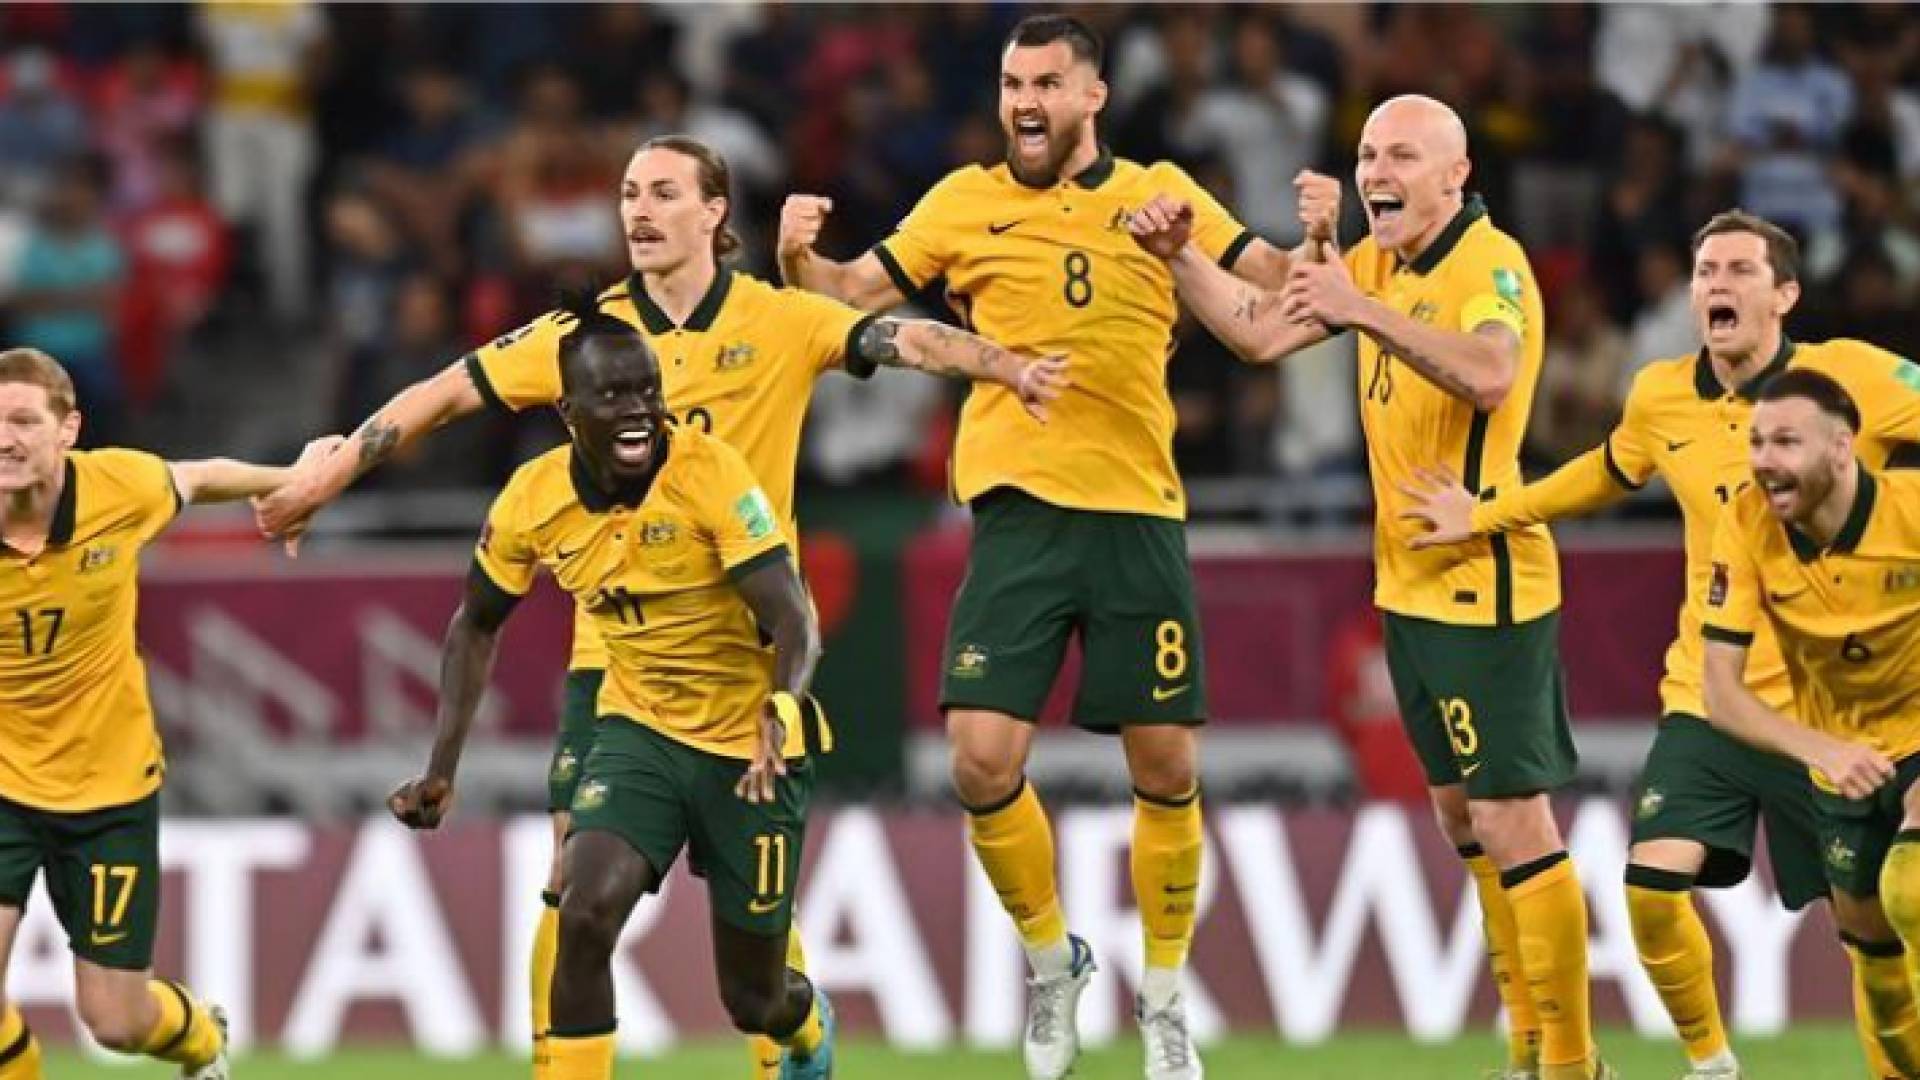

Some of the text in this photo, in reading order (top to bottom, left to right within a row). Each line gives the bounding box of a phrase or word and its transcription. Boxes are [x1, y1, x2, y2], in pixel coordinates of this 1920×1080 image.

[1064, 250, 1094, 309] 8
[16, 607, 65, 656] 17
[1155, 618, 1187, 679] 8
[1841, 632, 1873, 662] 6
[1439, 697, 1478, 756] 13
[752, 832, 785, 896] 11
[91, 863, 139, 927] 17
